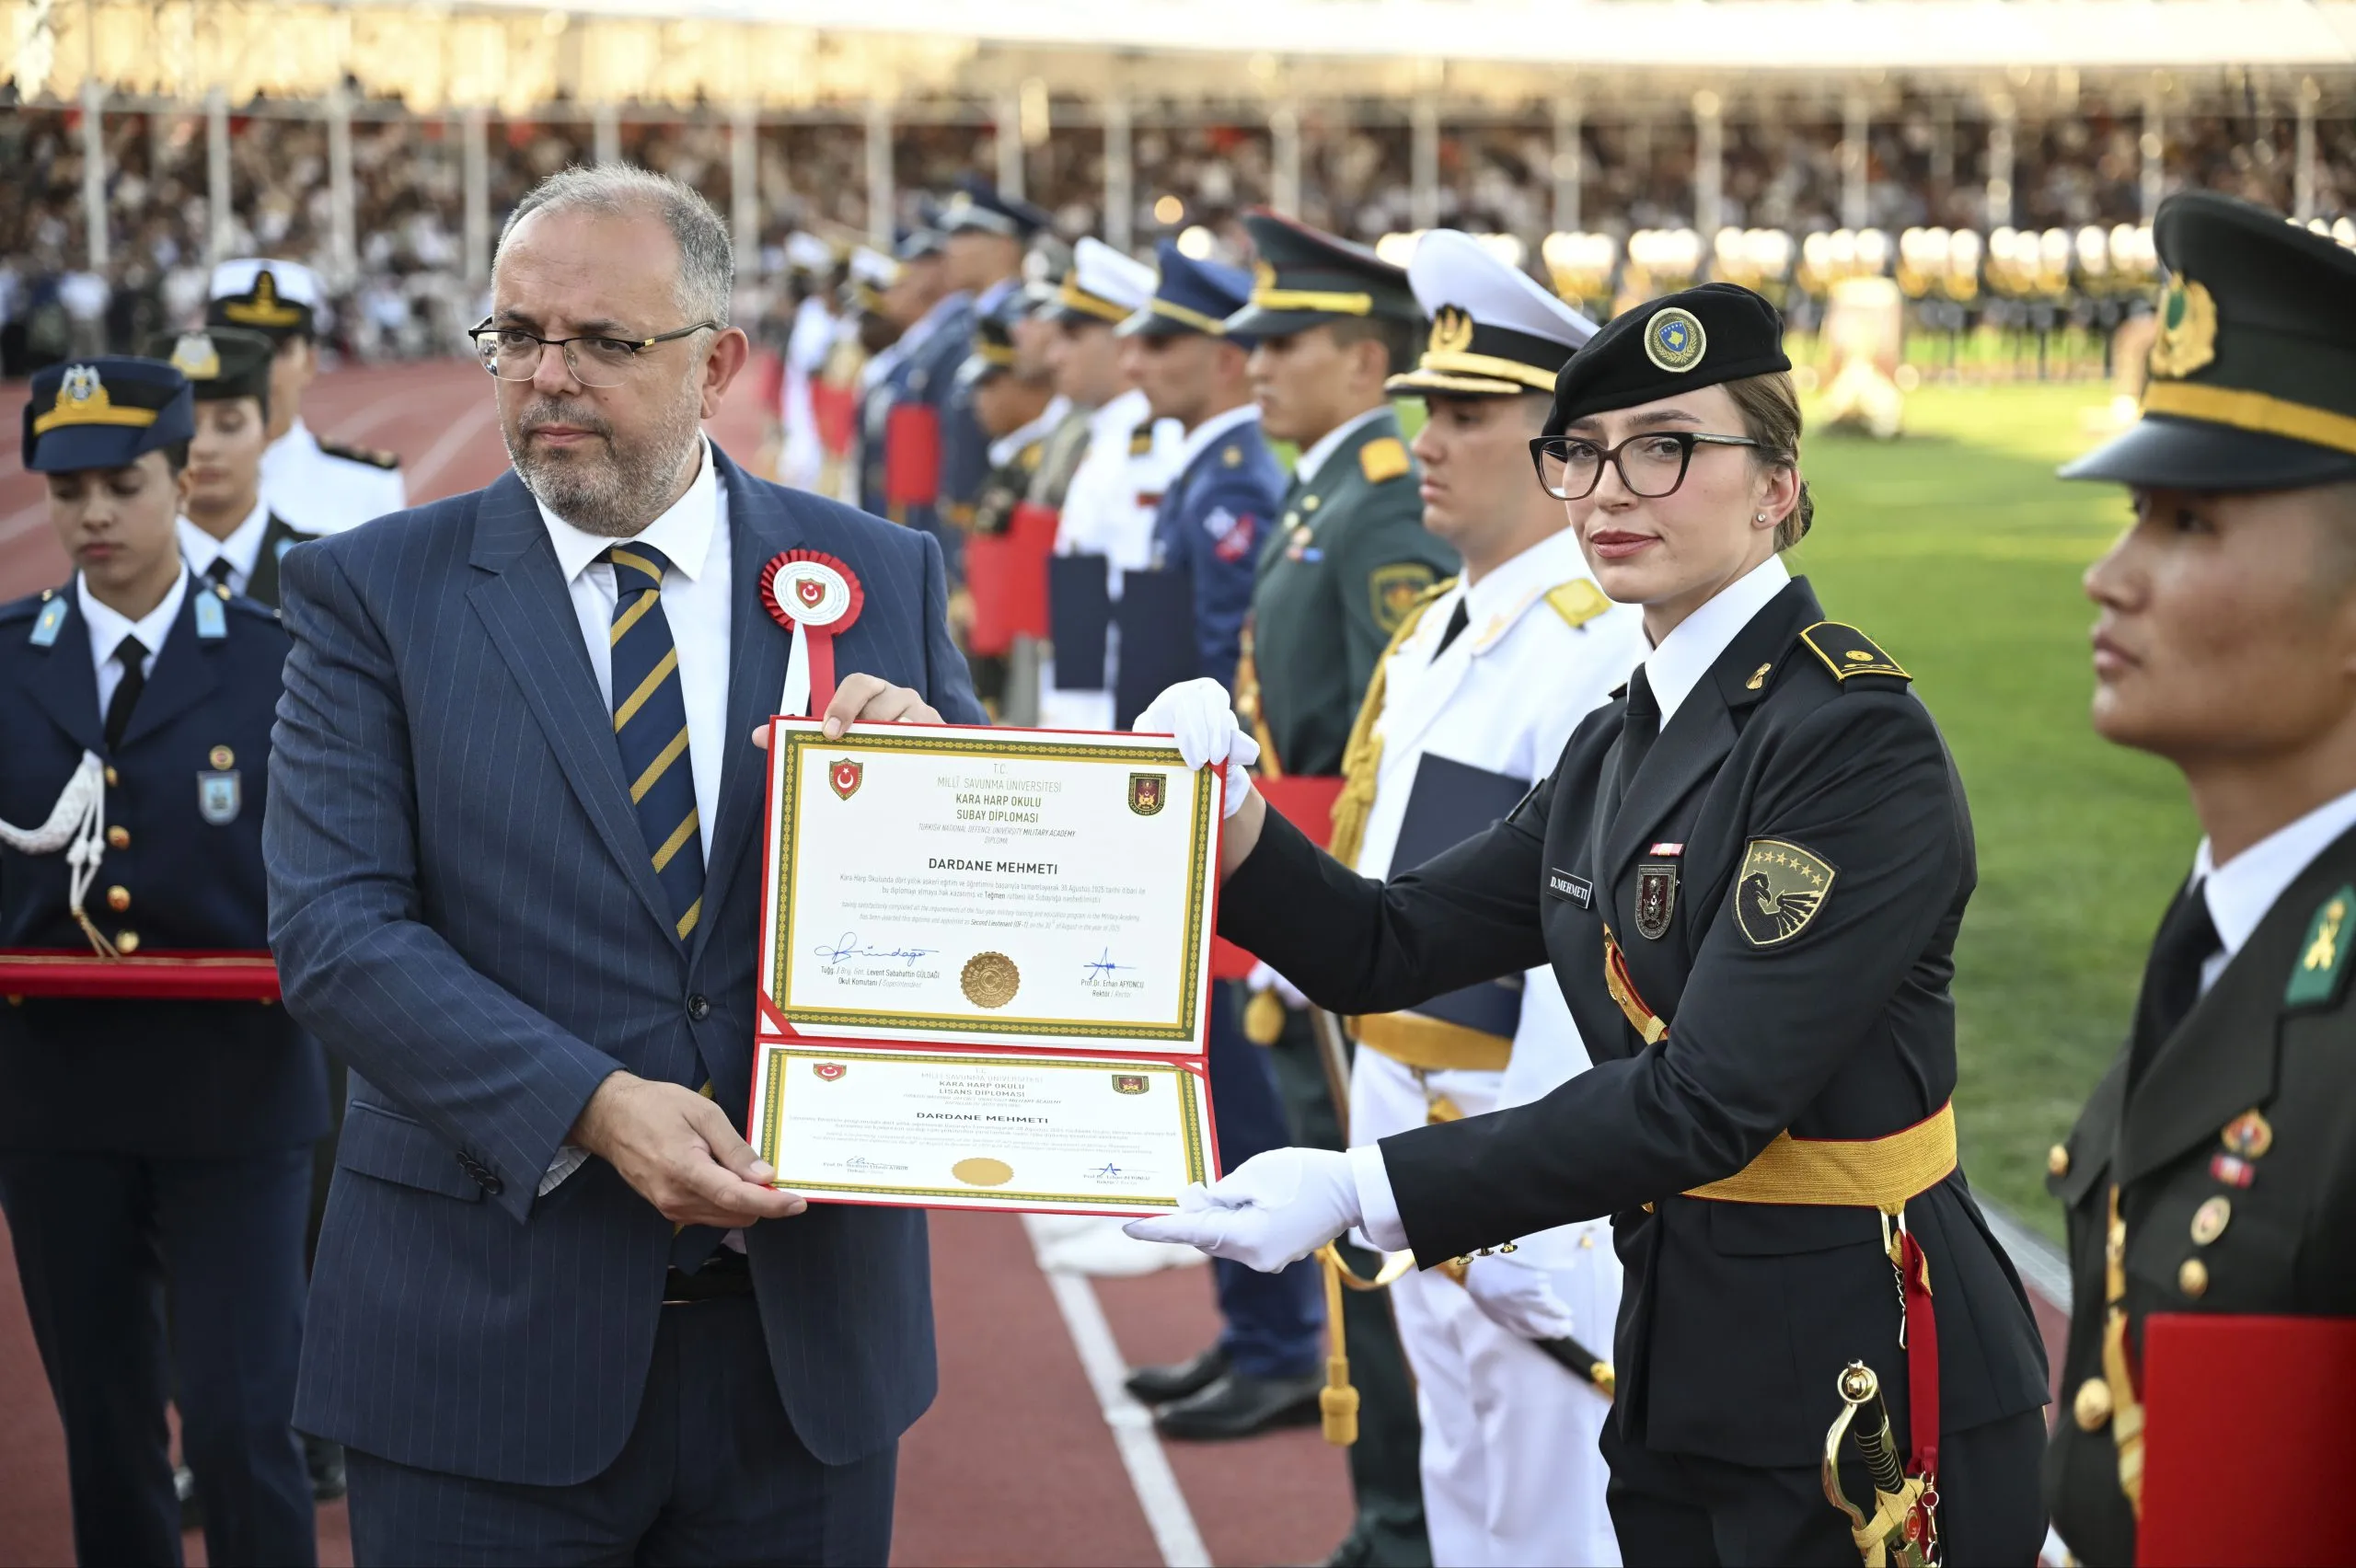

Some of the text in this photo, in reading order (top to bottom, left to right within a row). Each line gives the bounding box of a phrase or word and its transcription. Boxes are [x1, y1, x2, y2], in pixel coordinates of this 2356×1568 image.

[994, 763, 1008, 775] T.C.
[964, 778, 1003, 790] SAVUNMA
[955, 793, 1042, 808] KARA HARP OKULU
[956, 809, 1039, 824] SUBAY DİPLOMASI
[918, 823, 941, 832] TURKISH
[941, 824, 966, 834] NATIONAL
[992, 826, 1022, 836] UNIVERSITY
[1022, 827, 1049, 837] MILITARY
[1049, 828, 1077, 838] ACADEMY
[984, 836, 1009, 845] DIPLOMA
[928, 858, 1058, 875] DARDANE MEHMETI
[1550, 875, 1588, 901] D.MEHMETI
[985, 891, 1006, 901] Teğmen
[866, 968, 885, 977] Levent
[885, 969, 916, 978] Sabahattin
[852, 977, 879, 986] Komutanı
[994, 1082, 1025, 1090] OKULU
[939, 1087, 1025, 1098] LİSANS DİPLOMASI
[916, 1112, 982, 1122] DARDANE
[986, 1115, 1049, 1124] MEHMETI
